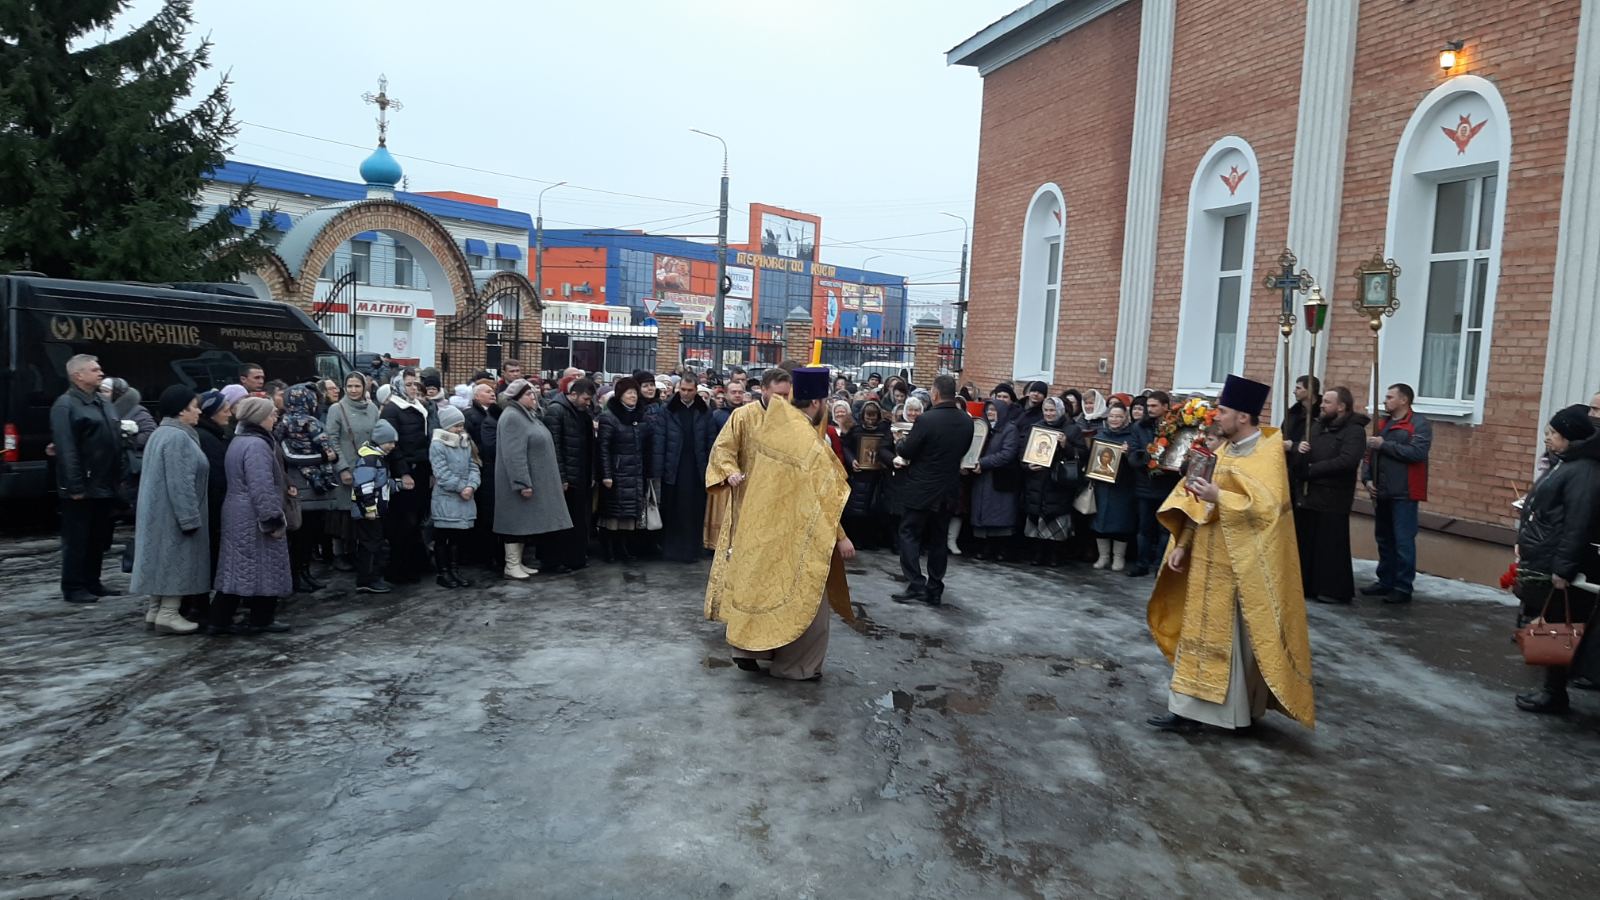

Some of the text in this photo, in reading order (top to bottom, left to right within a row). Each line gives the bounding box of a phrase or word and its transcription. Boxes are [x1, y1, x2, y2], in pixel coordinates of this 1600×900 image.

[737, 252, 804, 272] ТЕРНОВСИЙ
[357, 302, 411, 315] МАГНИТ
[82, 317, 201, 346] ВОЗНЕСЕНИЕ
[220, 327, 304, 342] РИТУАЛЬНАЯ СЛУЖБА
